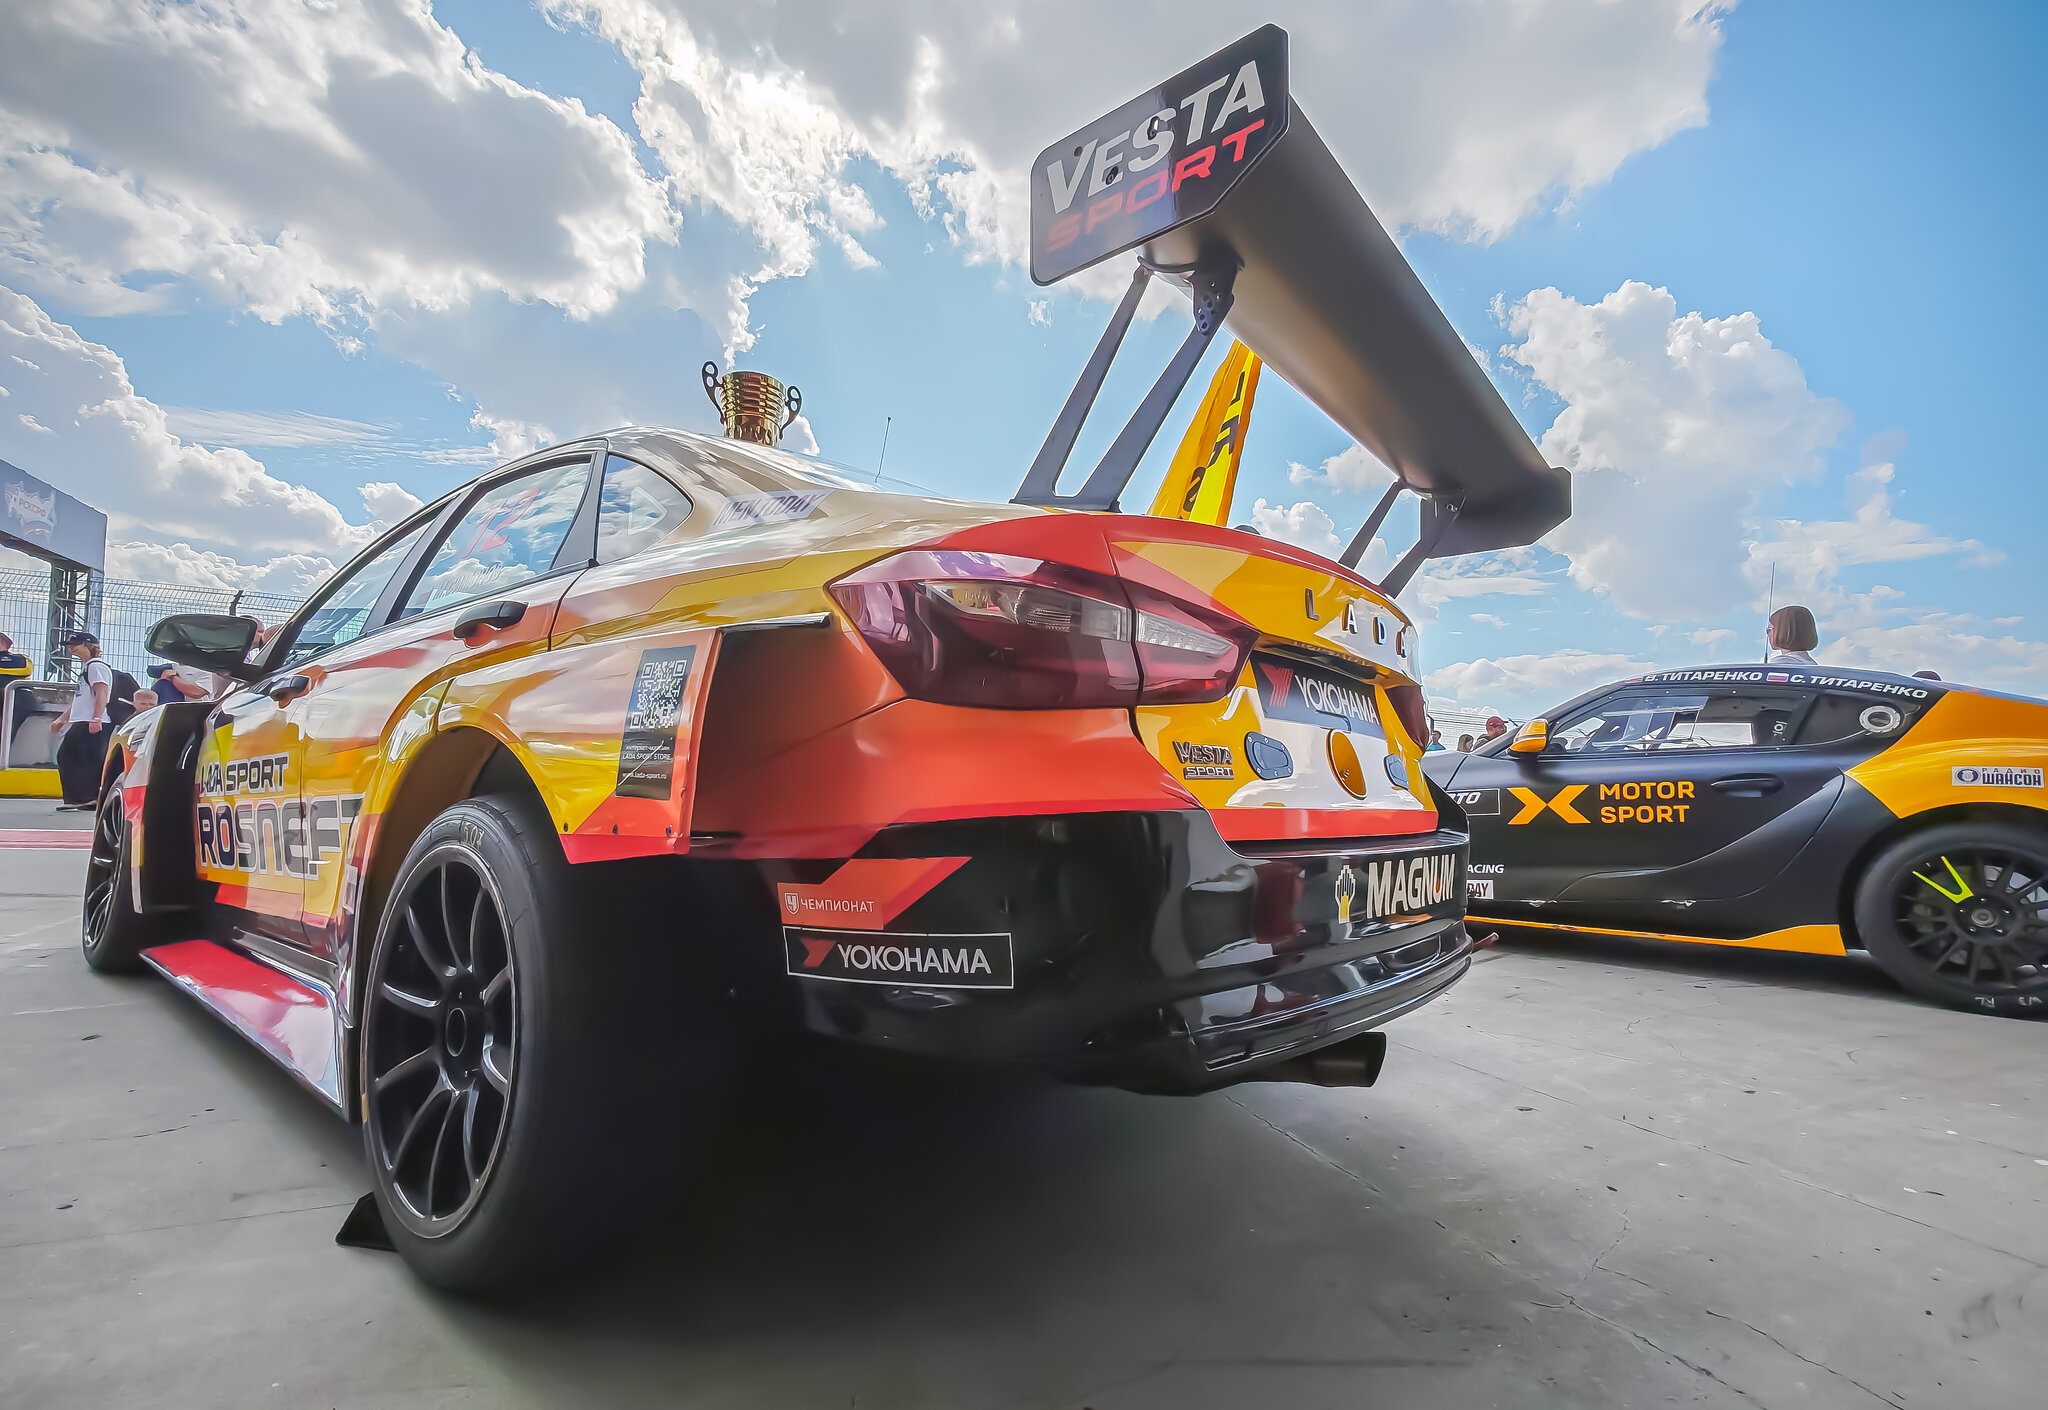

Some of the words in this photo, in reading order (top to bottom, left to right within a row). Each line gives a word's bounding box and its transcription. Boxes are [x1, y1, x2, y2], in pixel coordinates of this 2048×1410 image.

[1047, 60, 1265, 214] VESTA
[1046, 119, 1265, 253] SPORT
[1661, 671, 1763, 681] ТИТАРЕНКО
[1790, 674, 1806, 684] С.
[1810, 675, 1929, 699] ТИТАРЕНКО
[1294, 674, 1380, 726] YOKOHAMA
[1172, 740, 1234, 765] VESTA
[225, 754, 289, 795] SPORT
[1185, 766, 1234, 777] SPORT
[1982, 773, 2042, 786] ШАНСОН
[1600, 781, 1695, 800] MOTOR
[1601, 805, 1690, 823] SPORT
[1367, 853, 1456, 919] MAGNUM
[800, 899, 875, 912] ЧЕМПИОНАТ
[837, 943, 992, 974] YOKOHAMA
